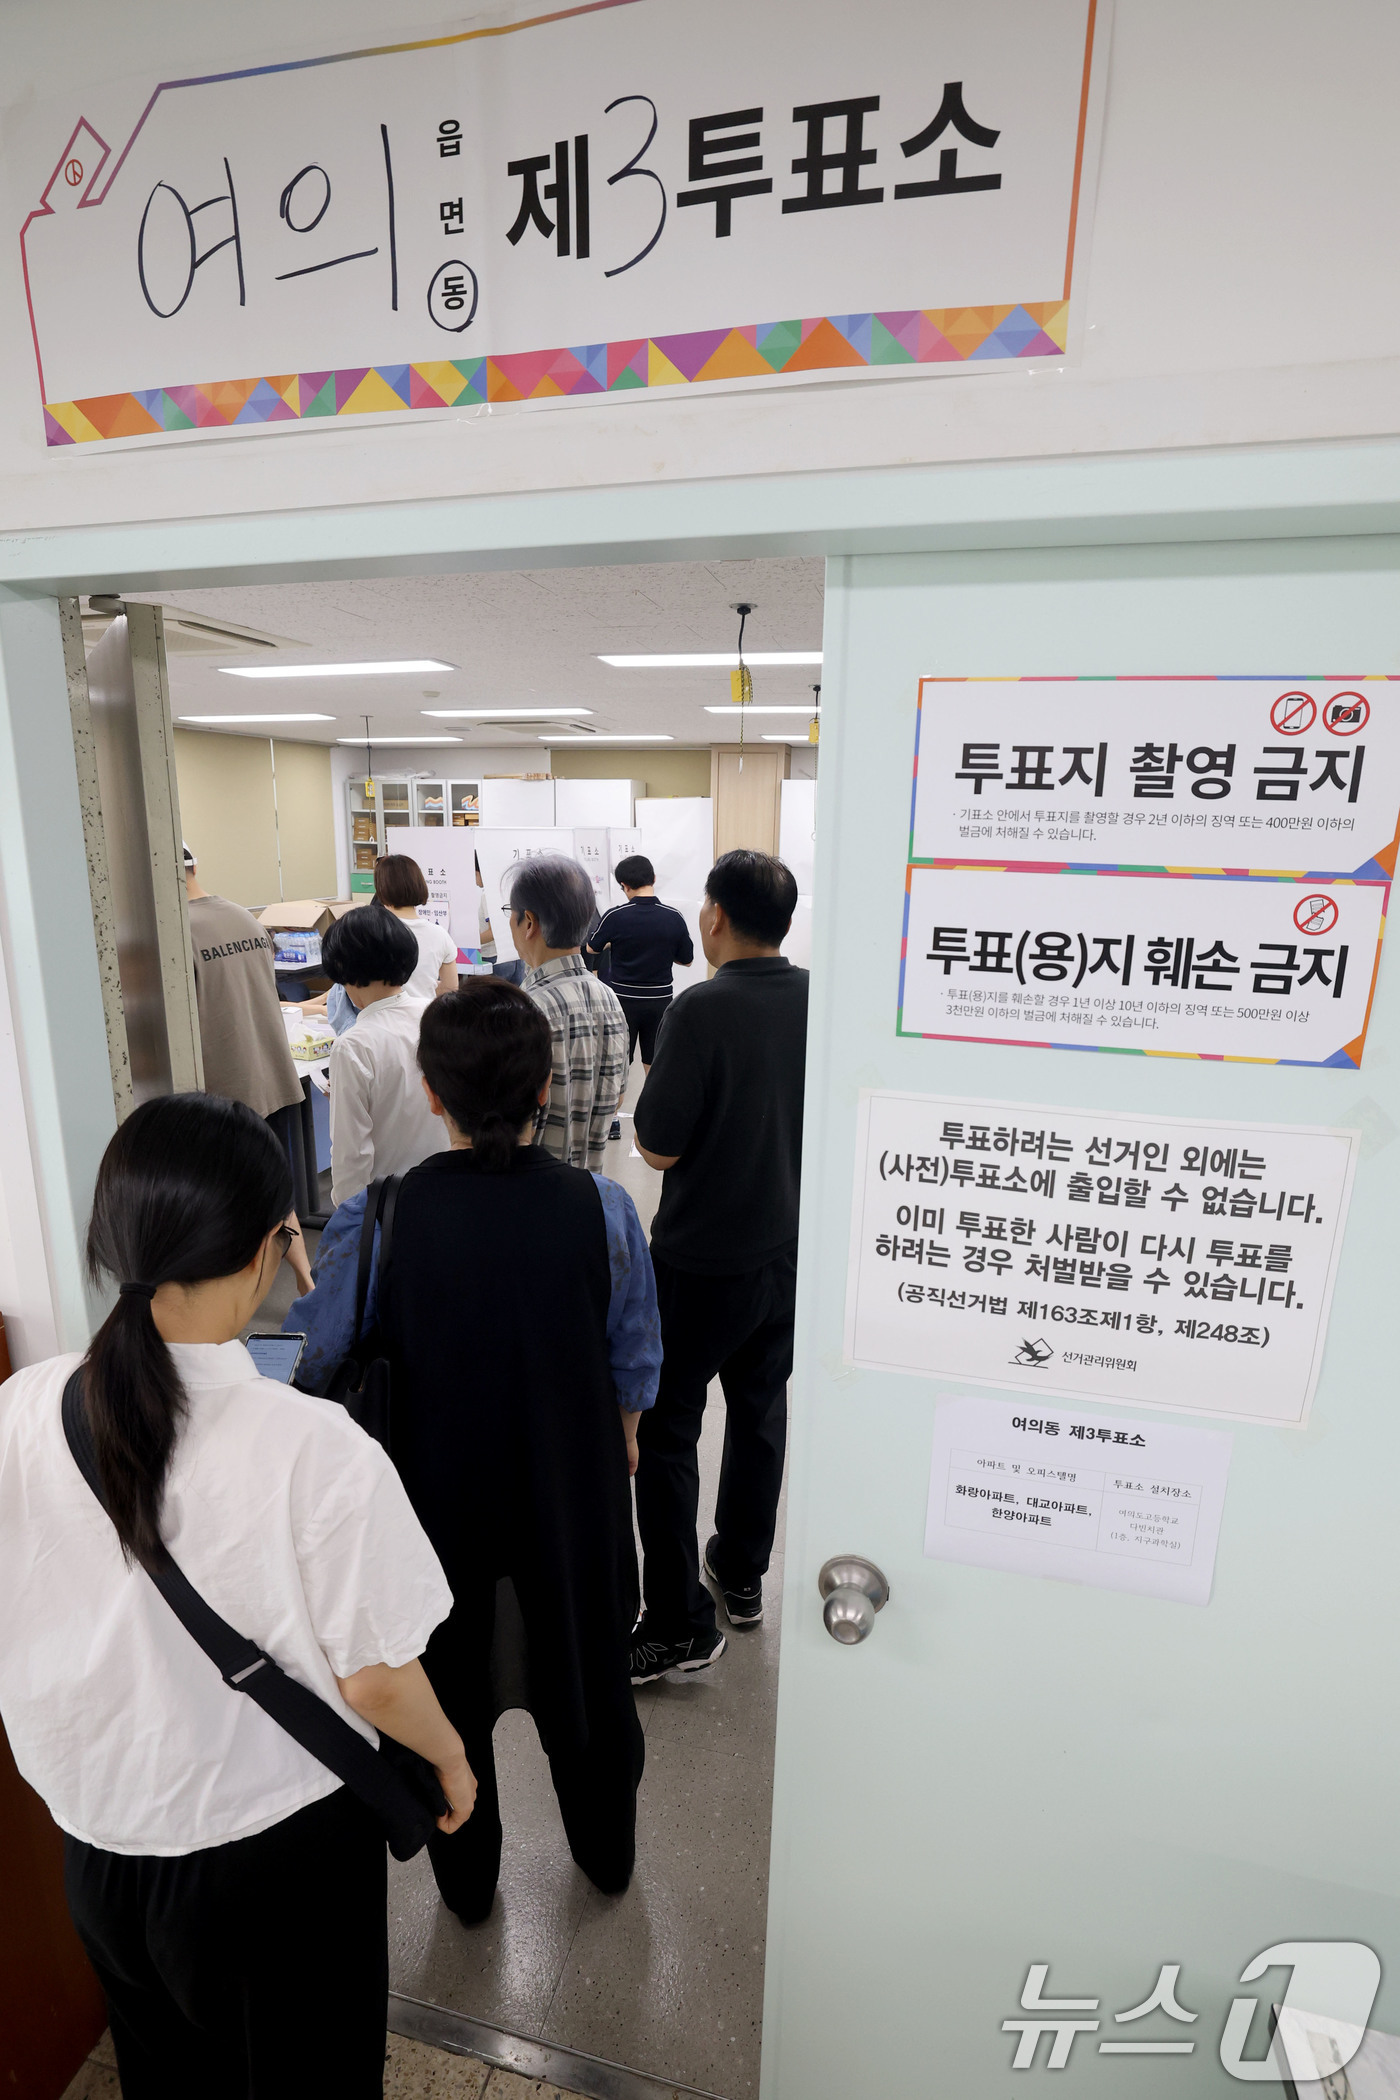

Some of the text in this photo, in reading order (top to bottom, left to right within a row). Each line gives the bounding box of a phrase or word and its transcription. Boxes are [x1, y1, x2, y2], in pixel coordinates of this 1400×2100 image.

[435, 119, 463, 158] 읍
[505, 81, 1002, 278] 제3투표소
[138, 123, 398, 318] 여의
[439, 198, 465, 236] 면
[440, 275, 468, 311] 동
[954, 742, 1366, 803] 투표지 촬영 금지
[959, 826, 1097, 842] 벌금에 처해질 수 있습니다.
[960, 809, 1355, 831] 기표소 안에서 투표지를 촬영할 경우 2년 이하의 징역 또는 400만원 이하의
[428, 868, 446, 876] 표소
[926, 927, 1349, 999] 투표(용)지 훼손 금지
[945, 1004, 1159, 1030] 3천만원 이하의 벌금에 처해질 수 있습니다.
[947, 989, 1310, 1023] 투표(용)지를 훼손할 경우 1년 이상 10년 이하의 징역 또는 500만원 이상
[940, 1121, 1267, 1181] 투표하려는 선거인 외에는
[879, 1151, 1323, 1225] (사전)투표소에 출입할 수 없습니다.
[896, 1204, 1293, 1273] 이미 투표한 사람이 다시 투표를
[875, 1233, 1304, 1310] 하려는 경우 처벌받을 수 있습니다.
[897, 1281, 1270, 1349] (공직선거법 제163조제1항, 제248조)
[1061, 1349, 1137, 1372] 선거관리위원회
[1011, 1416, 1146, 1448] 여의동 제3투표소
[976, 1458, 1077, 1483] 아파트 및 오피스텔명
[955, 1484, 1092, 1517] 화랑아파트, 대교아파트,
[1113, 1480, 1192, 1498] 투표소 설치장소
[991, 1507, 1052, 1527] 한양아파트
